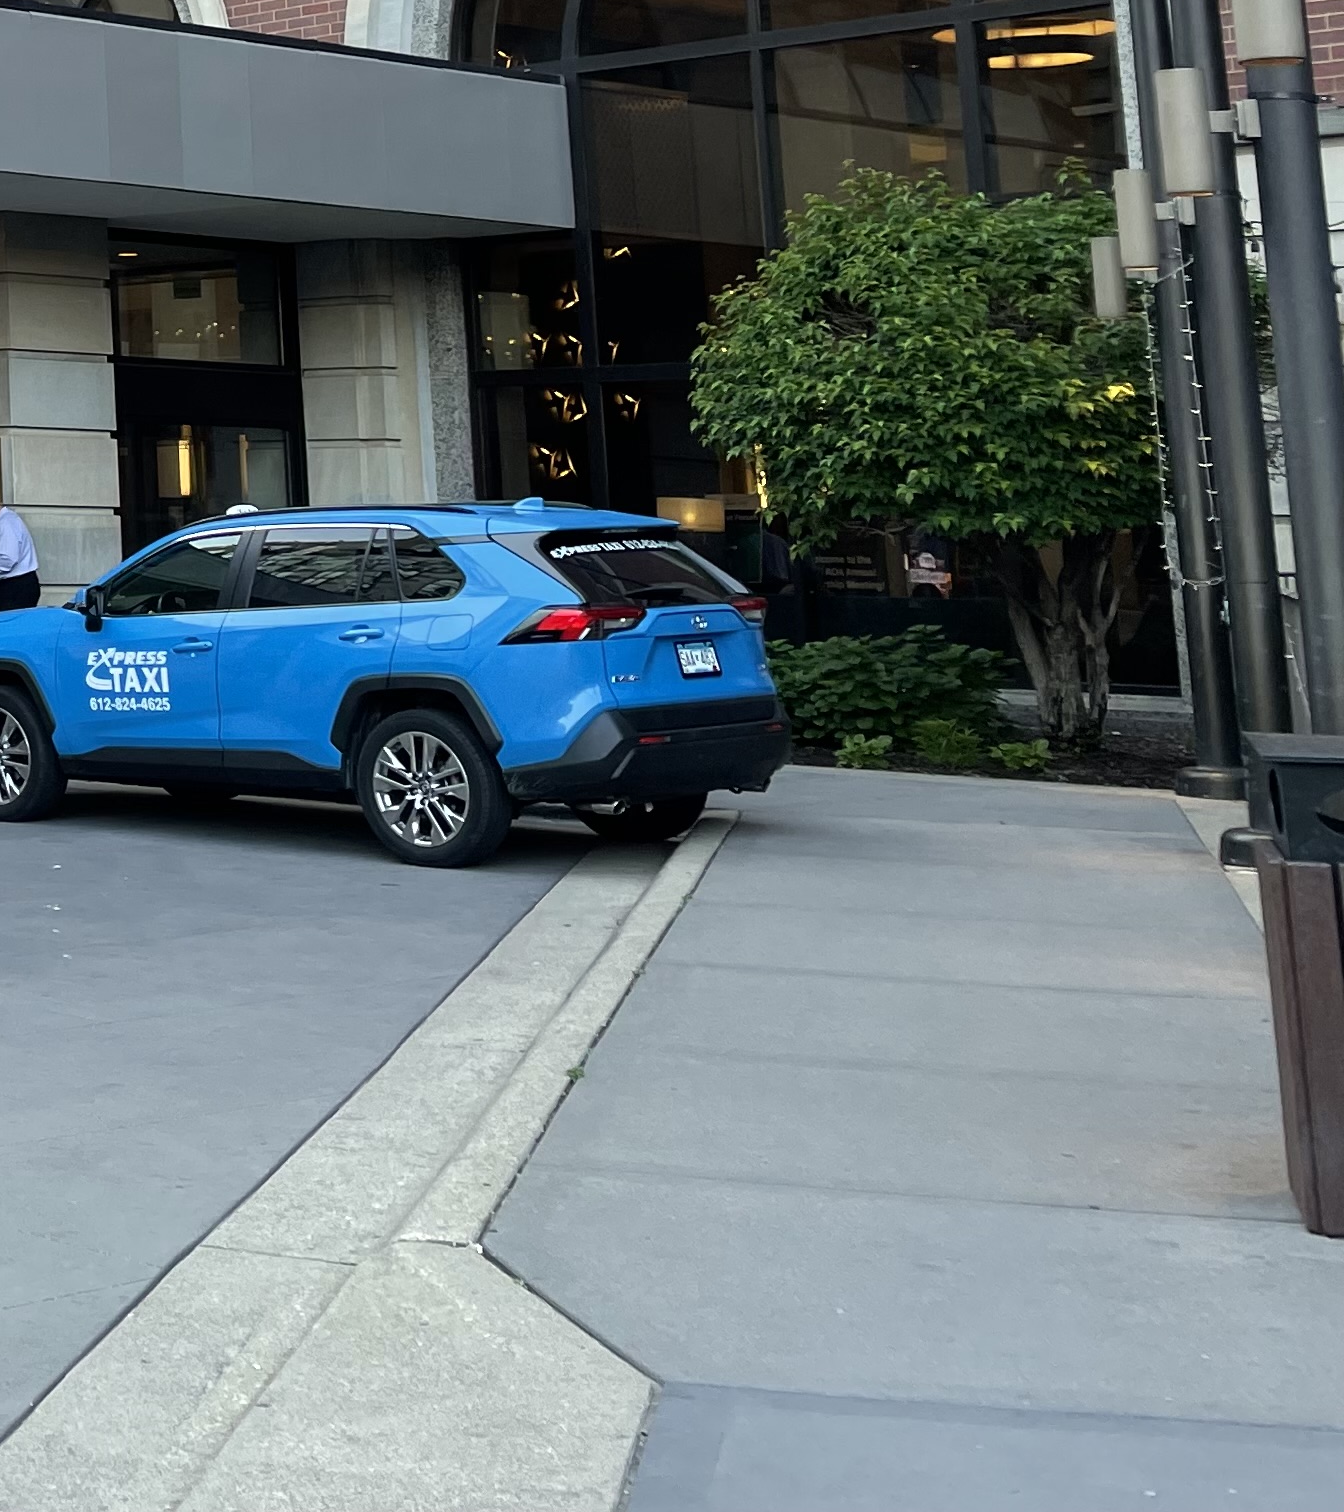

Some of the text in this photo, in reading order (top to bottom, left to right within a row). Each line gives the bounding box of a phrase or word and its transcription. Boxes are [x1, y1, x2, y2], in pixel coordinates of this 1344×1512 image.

[598, 540, 626, 552] TAXI
[87, 647, 168, 667] EXPRESS
[109, 667, 170, 693] TAXI
[89, 696, 171, 712] 612-824-4625
